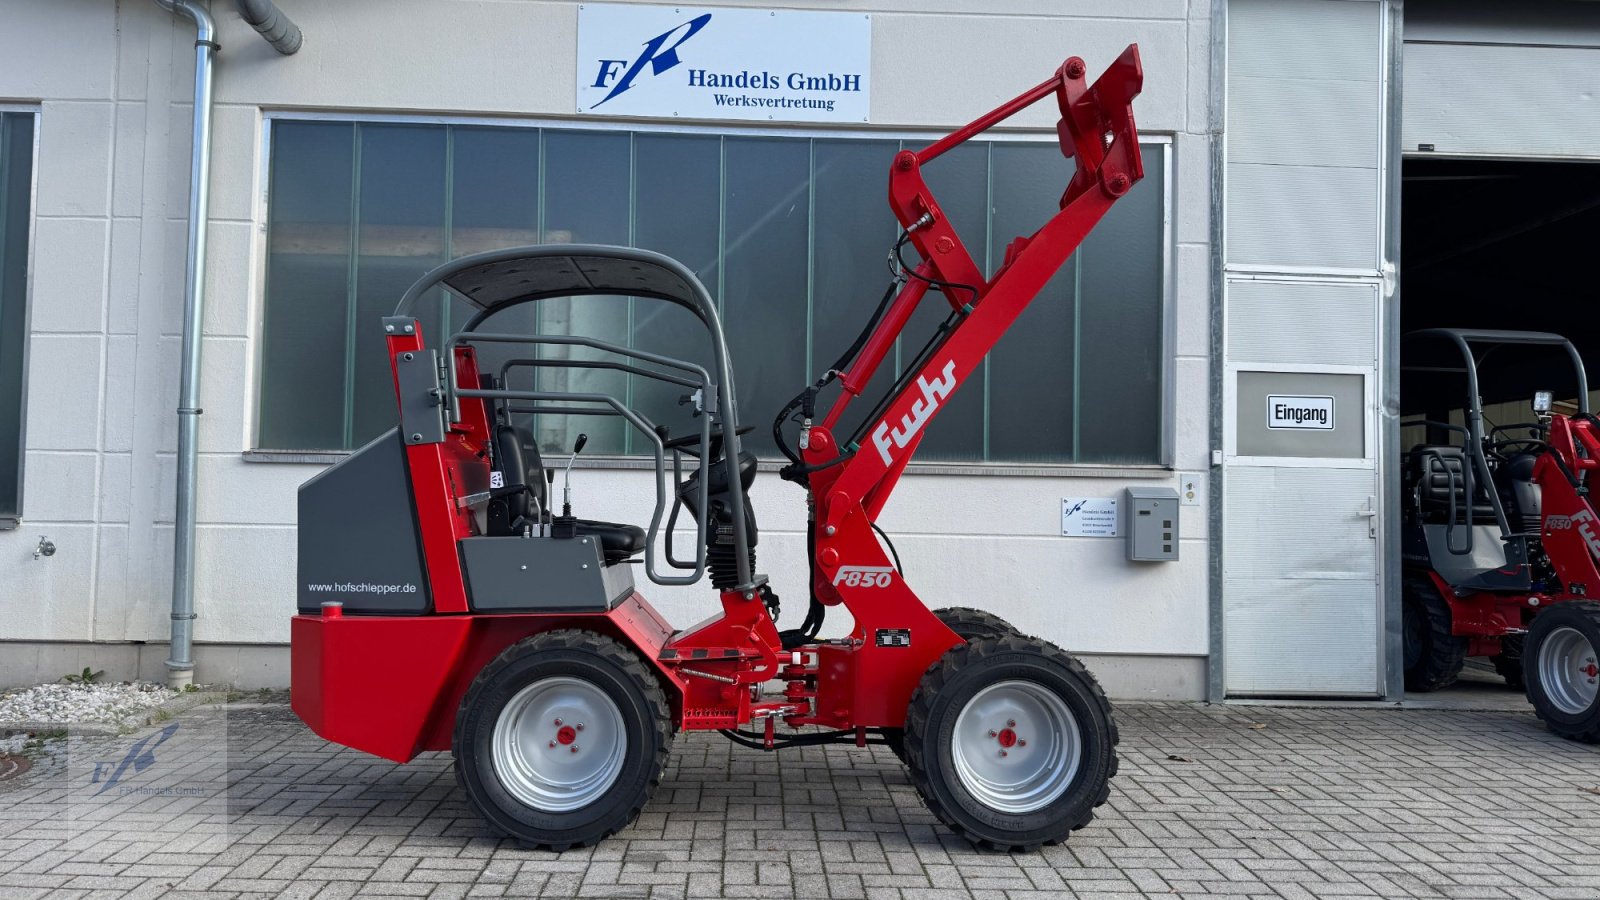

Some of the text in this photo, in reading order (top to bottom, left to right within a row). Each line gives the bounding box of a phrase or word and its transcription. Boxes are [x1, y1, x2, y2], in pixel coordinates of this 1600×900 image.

[688, 69, 861, 92] Handels GmbH
[714, 94, 836, 111] Werksvertretung
[871, 359, 957, 468] Fuchs
[1275, 403, 1327, 424] Eingang
[1544, 514, 1572, 530] F850
[832, 565, 895, 588] F850
[308, 582, 417, 595] www.hofschlepper.de
